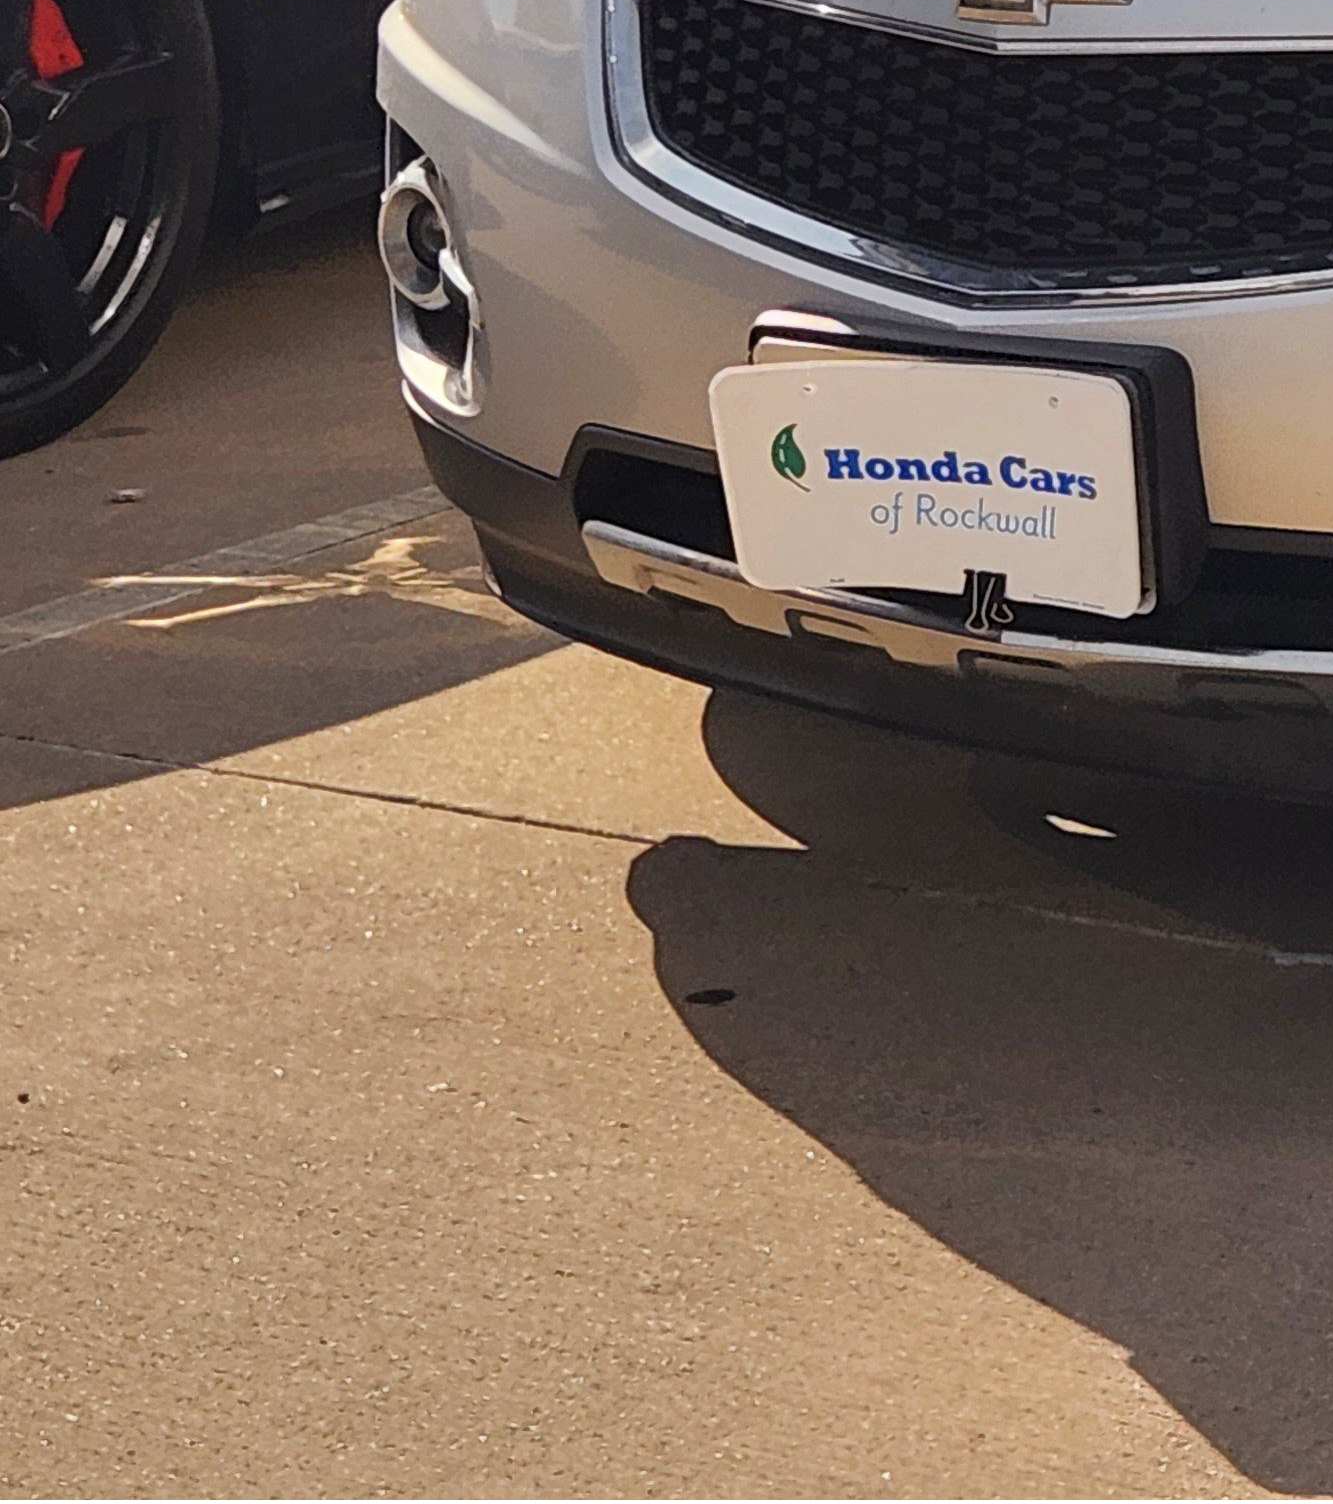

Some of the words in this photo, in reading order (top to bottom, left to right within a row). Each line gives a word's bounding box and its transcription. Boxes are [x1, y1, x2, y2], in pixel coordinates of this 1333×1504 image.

[824, 448, 993, 486] Honda
[1000, 455, 1098, 500] Cars
[870, 492, 903, 535] of
[916, 493, 1056, 539] Rockwall
